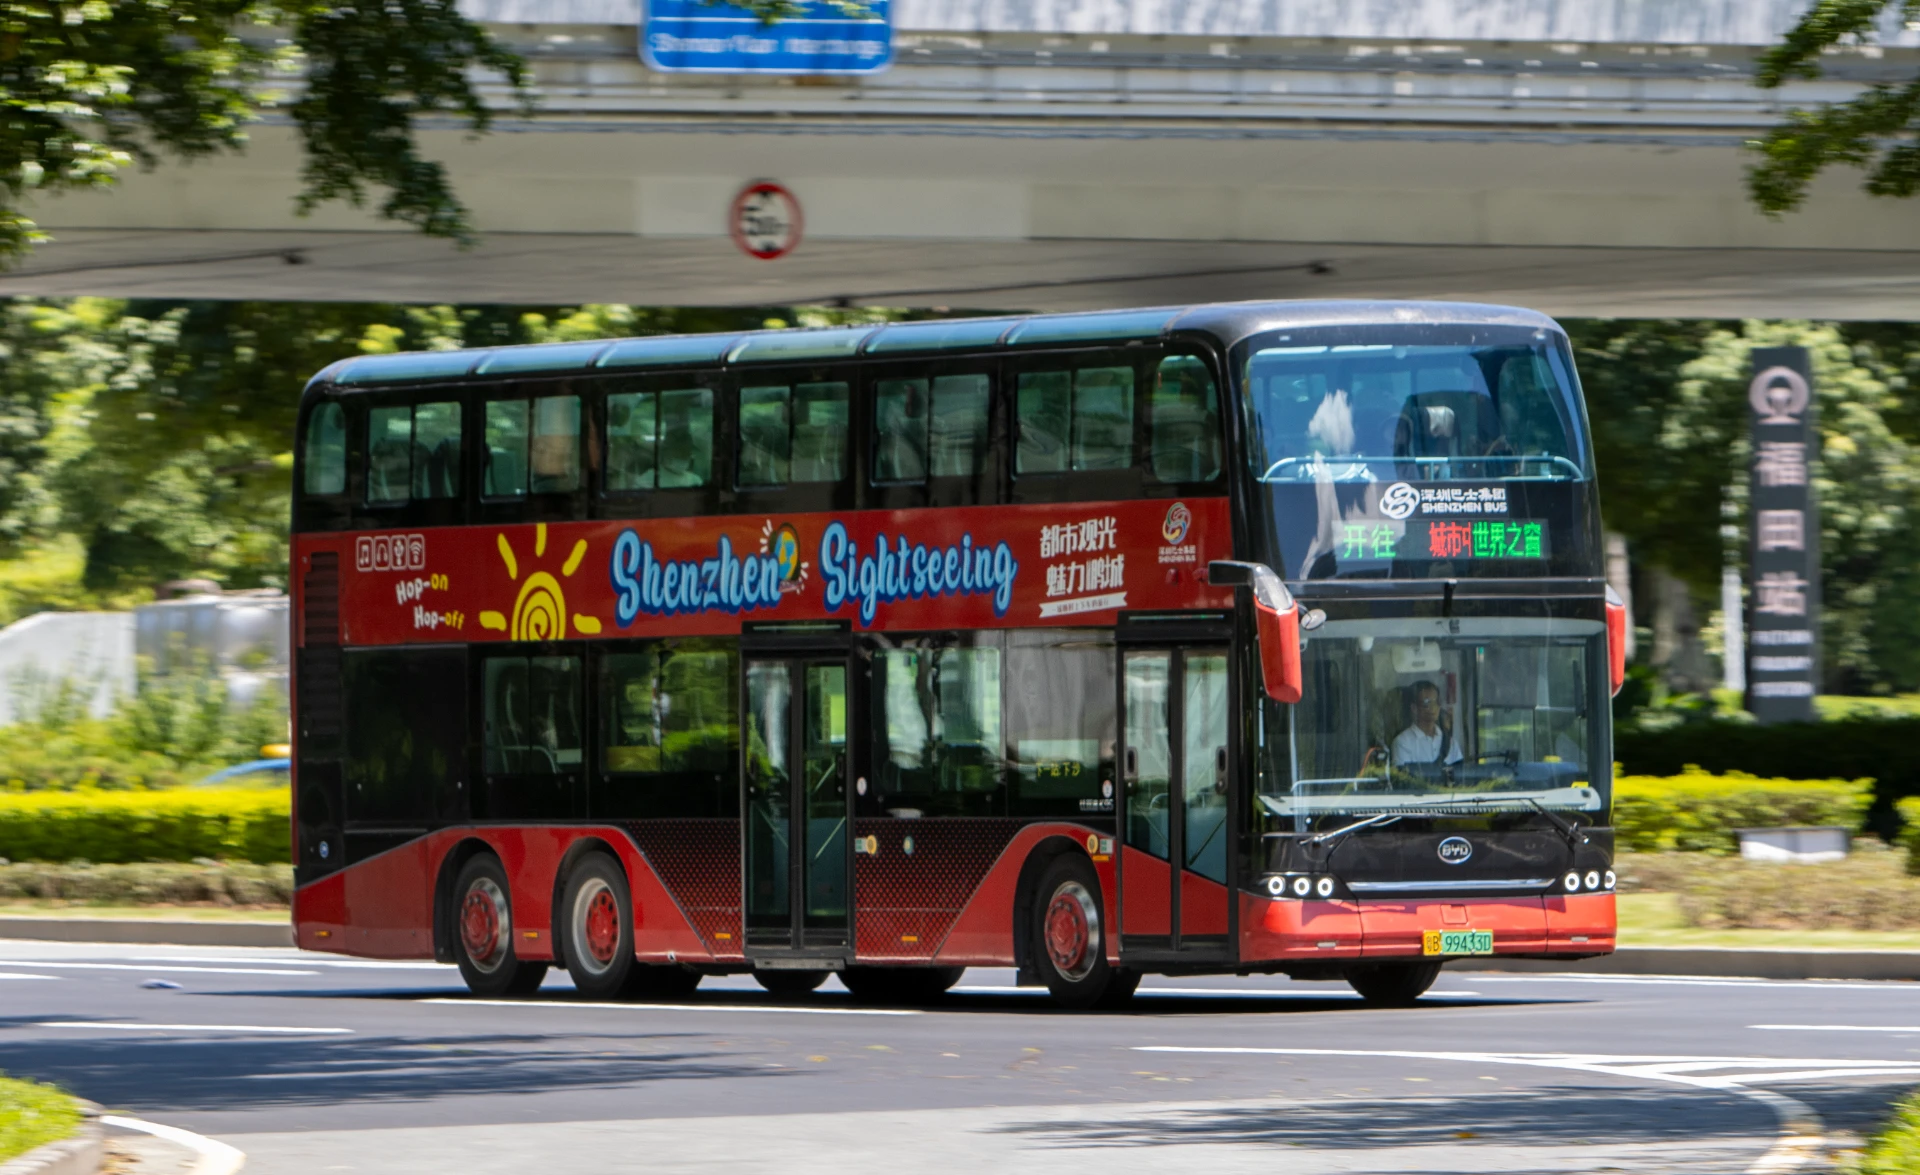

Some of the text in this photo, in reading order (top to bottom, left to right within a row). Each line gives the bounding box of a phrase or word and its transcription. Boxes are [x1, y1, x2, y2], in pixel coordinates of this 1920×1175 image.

[1421, 488, 1506, 501] 深圳巴士集团
[1422, 501, 1508, 513] SHENZHEN BUS
[1040, 516, 1117, 558] 都市观光
[1343, 523, 1397, 559] 开往
[1472, 521, 1542, 558] 世界之窗
[396, 573, 449, 605] Hop-on
[611, 520, 1018, 627] Shenzhen Sightseeing
[1046, 554, 1125, 597] 魅力鹏城
[413, 605, 465, 630] Hop-off
[1442, 844, 1469, 856] BYD
